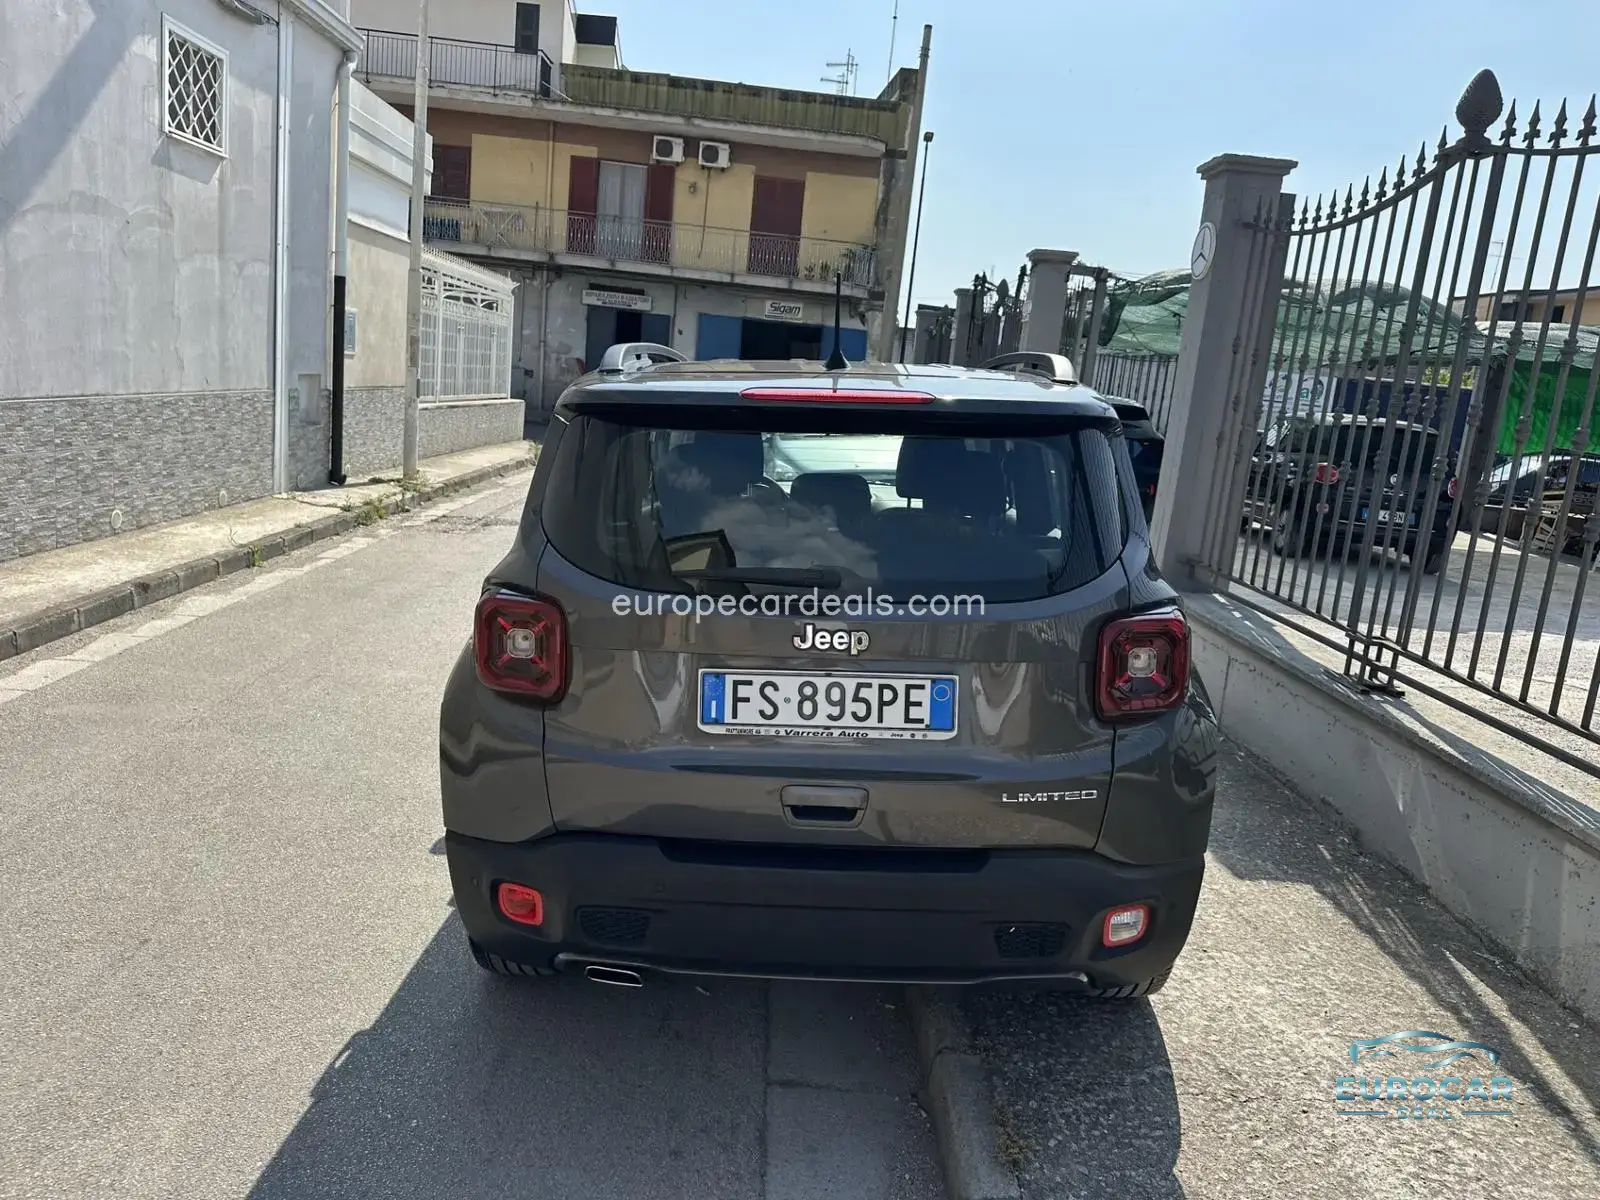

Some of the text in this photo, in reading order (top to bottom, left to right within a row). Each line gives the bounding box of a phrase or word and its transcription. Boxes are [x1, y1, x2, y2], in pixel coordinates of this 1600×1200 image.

[793, 624, 870, 656] Jeep
[731, 680, 780, 721] FS
[797, 680, 926, 724] 895PE
[784, 729, 834, 738] Varrera
[1002, 790, 1098, 802] LIMITED
